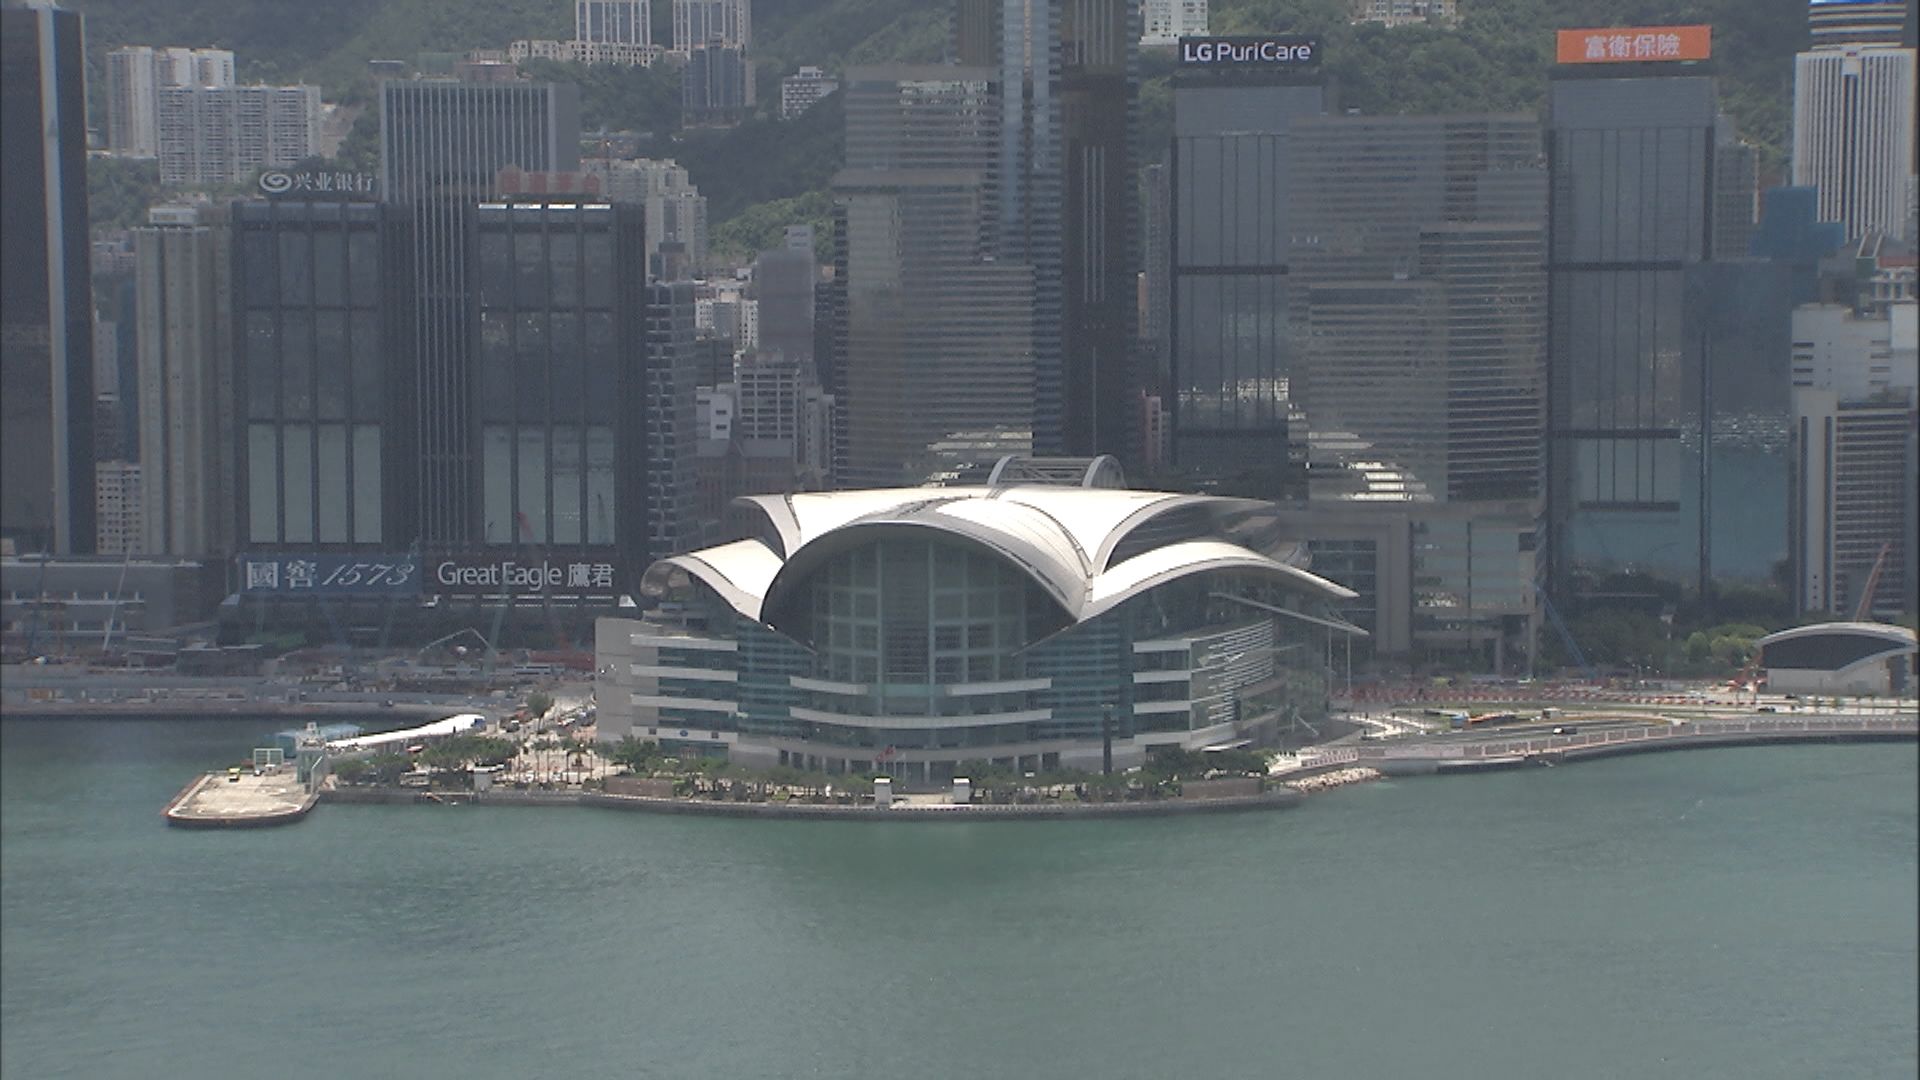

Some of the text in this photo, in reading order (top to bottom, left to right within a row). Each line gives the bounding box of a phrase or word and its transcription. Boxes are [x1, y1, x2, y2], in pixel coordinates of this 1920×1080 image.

[1184, 42, 1312, 61] LG PuriCare
[1585, 33, 1681, 58] 富衛保險
[295, 171, 373, 191] 兴业银行
[322, 563, 415, 586] 1573
[438, 560, 615, 591] Great Eagle 鷹君
